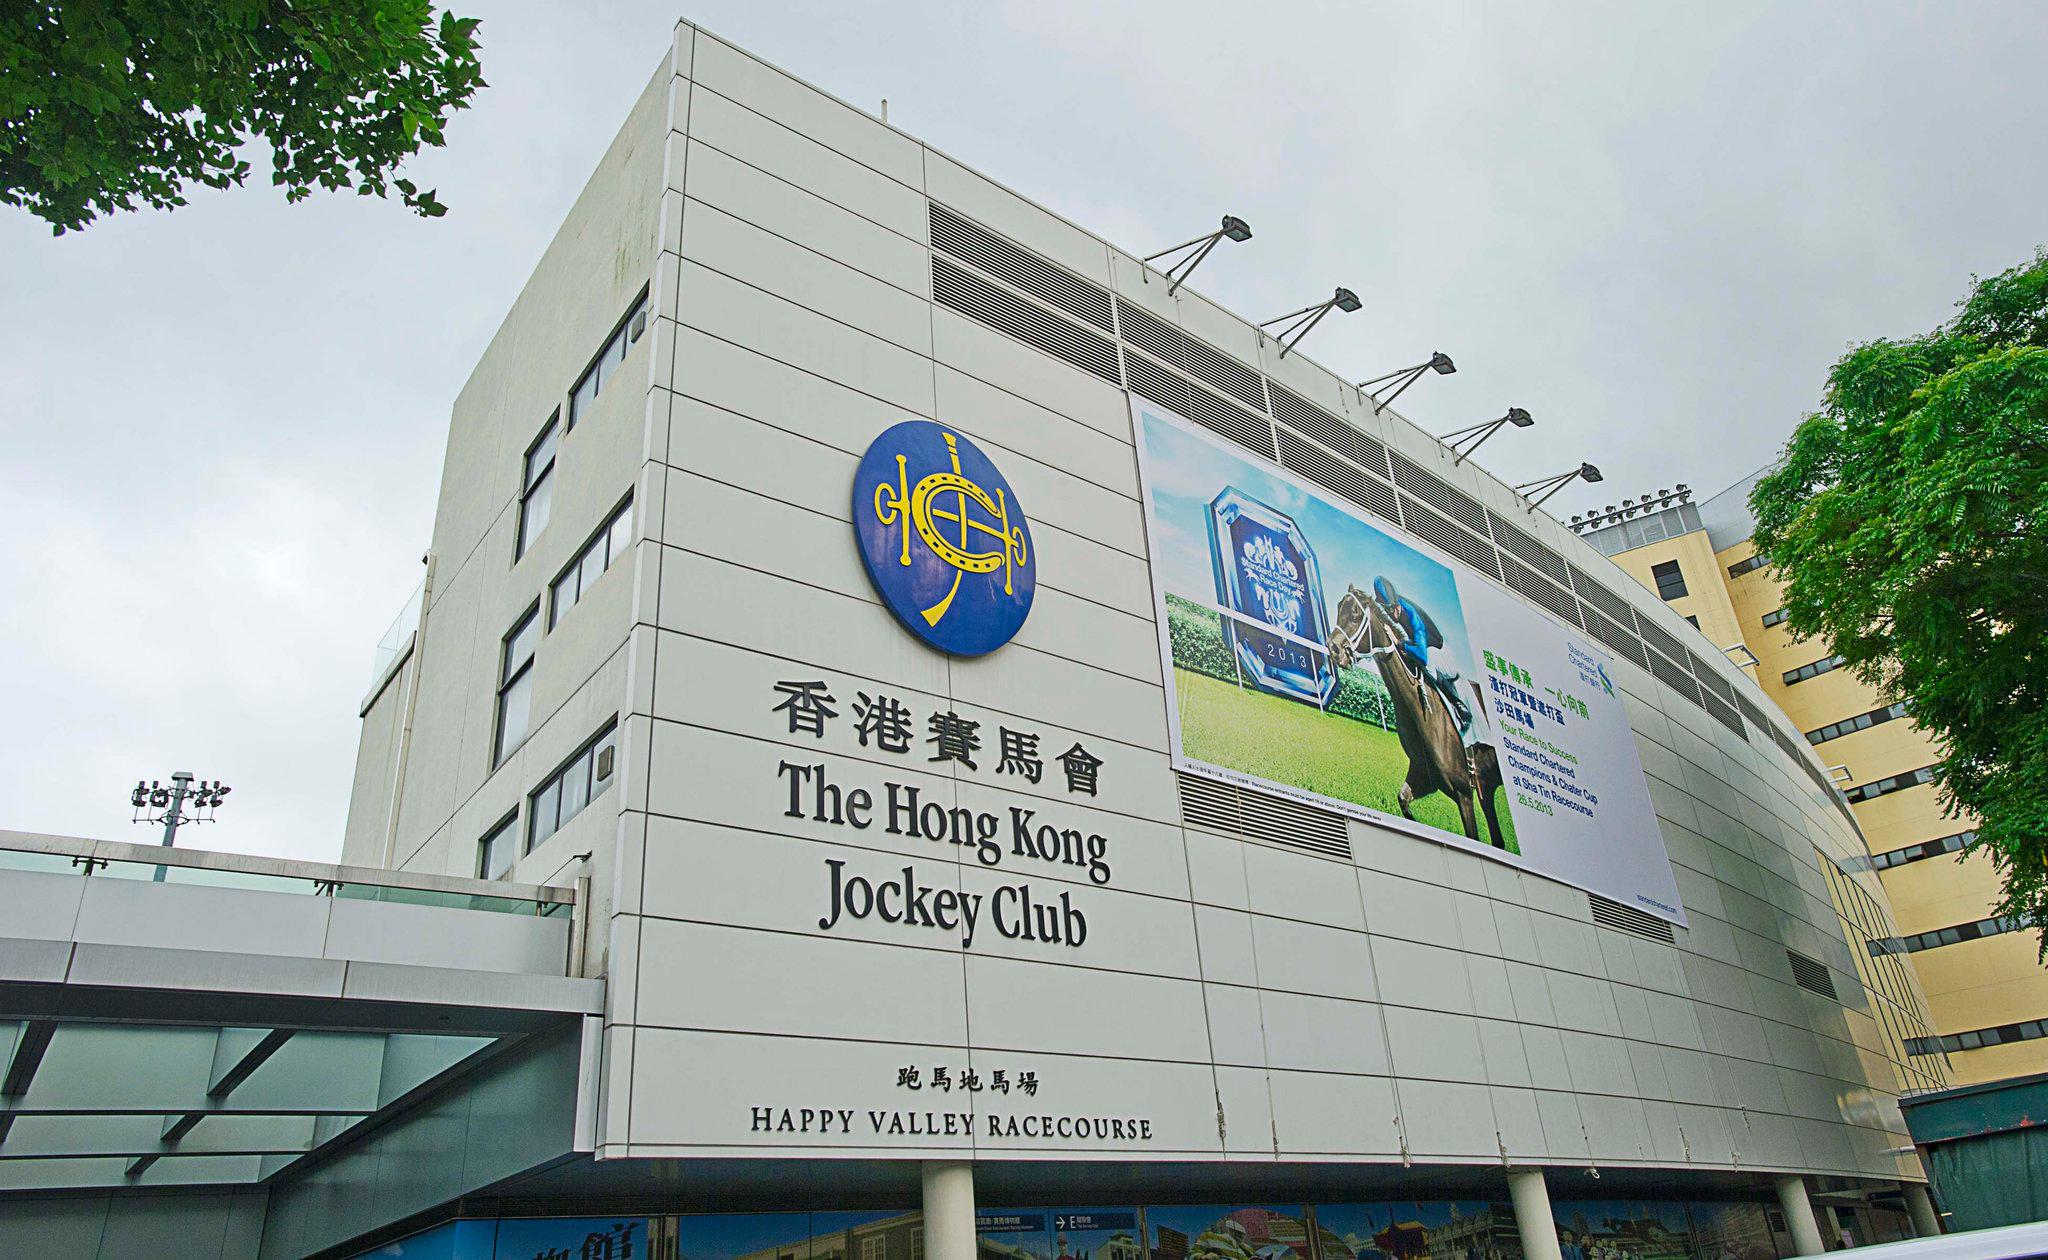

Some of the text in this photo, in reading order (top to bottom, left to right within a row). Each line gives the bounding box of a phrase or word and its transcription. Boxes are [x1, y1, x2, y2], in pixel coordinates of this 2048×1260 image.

[1241, 557, 1272, 578] Standard
[1259, 574, 1292, 595] Race Day
[1267, 644, 1307, 668] 2013
[772, 681, 1104, 797] 香港賽馬會
[1499, 719, 1578, 765] Your Race to Success
[1503, 736, 1576, 779] Standard Chartered
[1508, 755, 1598, 806] Champions & Chater Cup
[1512, 775, 1594, 818] at Sha Tin Racecourse
[778, 759, 1111, 885] The Hong Kong
[1517, 792, 1554, 817] 26.5.2013
[818, 858, 1087, 948] Jockey Club
[896, 1065, 1039, 1097] 跑馬地馬場
[750, 1106, 1153, 1140] HAPPY VALLEY RACECOURSE
